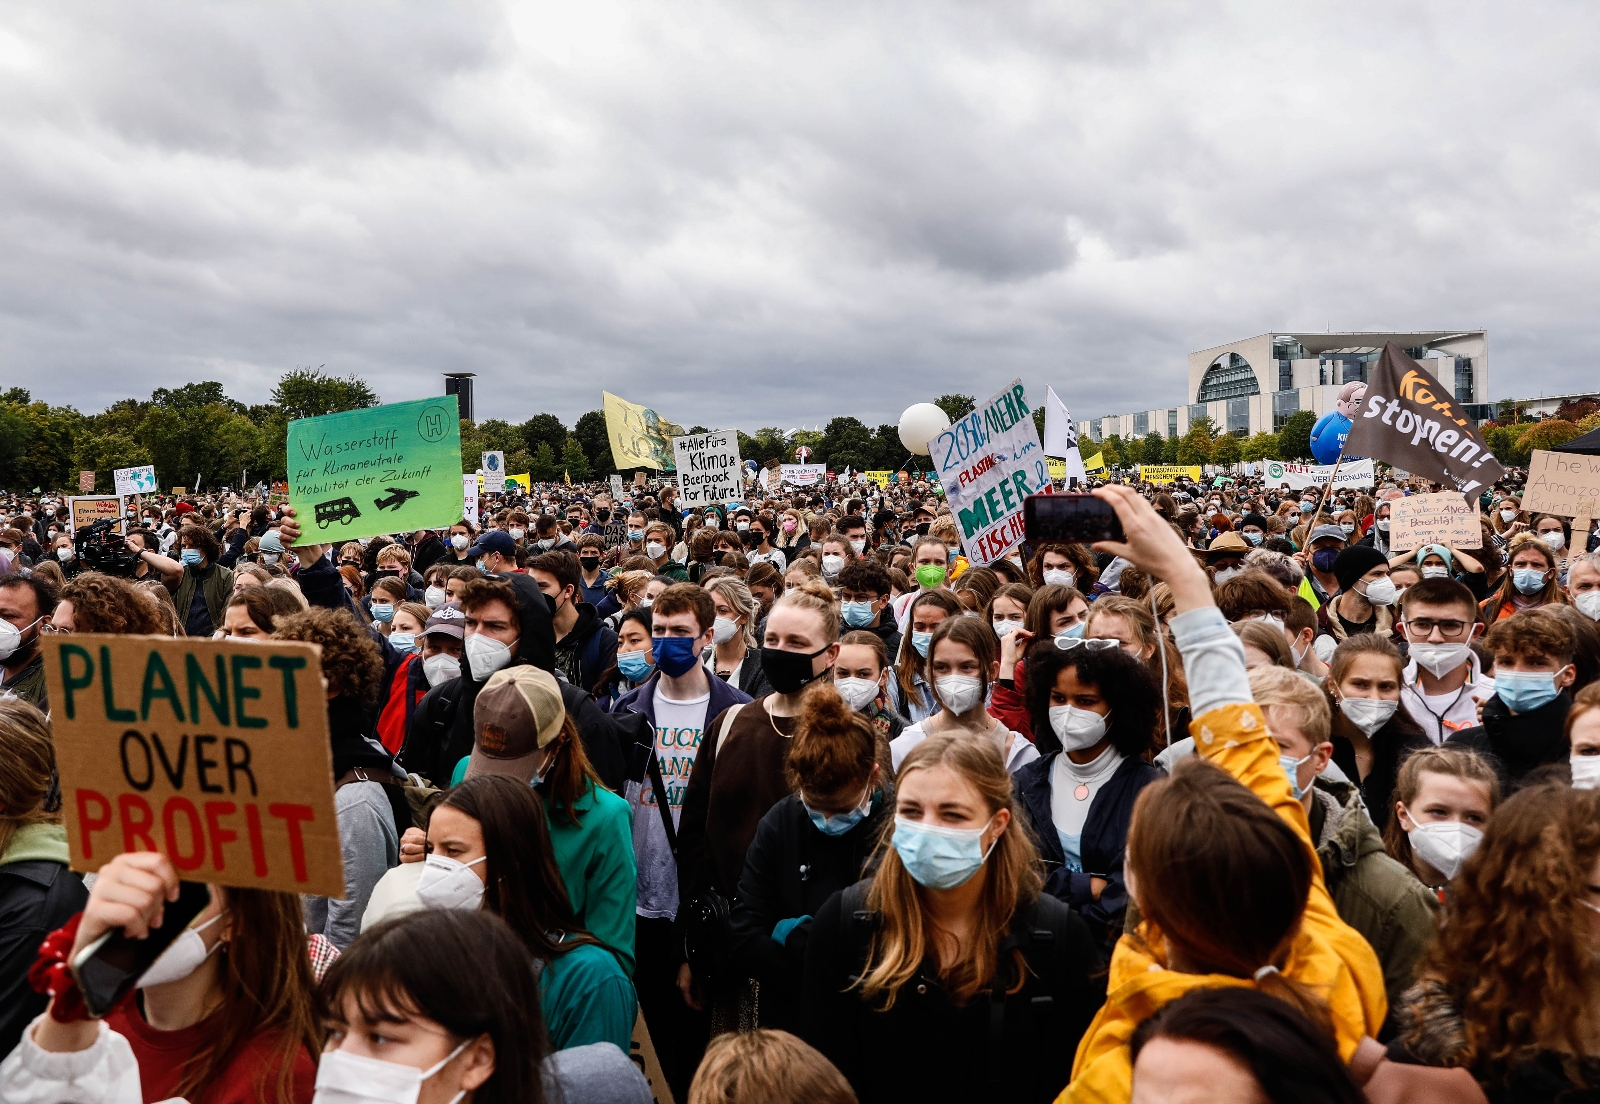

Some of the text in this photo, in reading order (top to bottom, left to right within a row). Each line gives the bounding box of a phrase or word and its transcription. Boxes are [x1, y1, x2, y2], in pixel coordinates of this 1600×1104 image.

[425, 413, 442, 437] H
[299, 429, 398, 461] Wasserstoff
[1013, 440, 1036, 461] im
[689, 451, 736, 471] Klima &
[1283, 463, 1310, 474] MUT
[1542, 452, 1582, 474] The
[295, 465, 432, 497] Mobilität der Zukunft
[296, 468, 316, 484] für
[682, 468, 730, 487] Baerbock
[683, 487, 701, 501] For
[958, 469, 1033, 540] MEER
[1411, 505, 1439, 514] haben
[604, 525, 626, 536] DAS
[59, 643, 307, 729] PLANET
[120, 729, 257, 797] OVER
[76, 788, 315, 883] PROFIT
